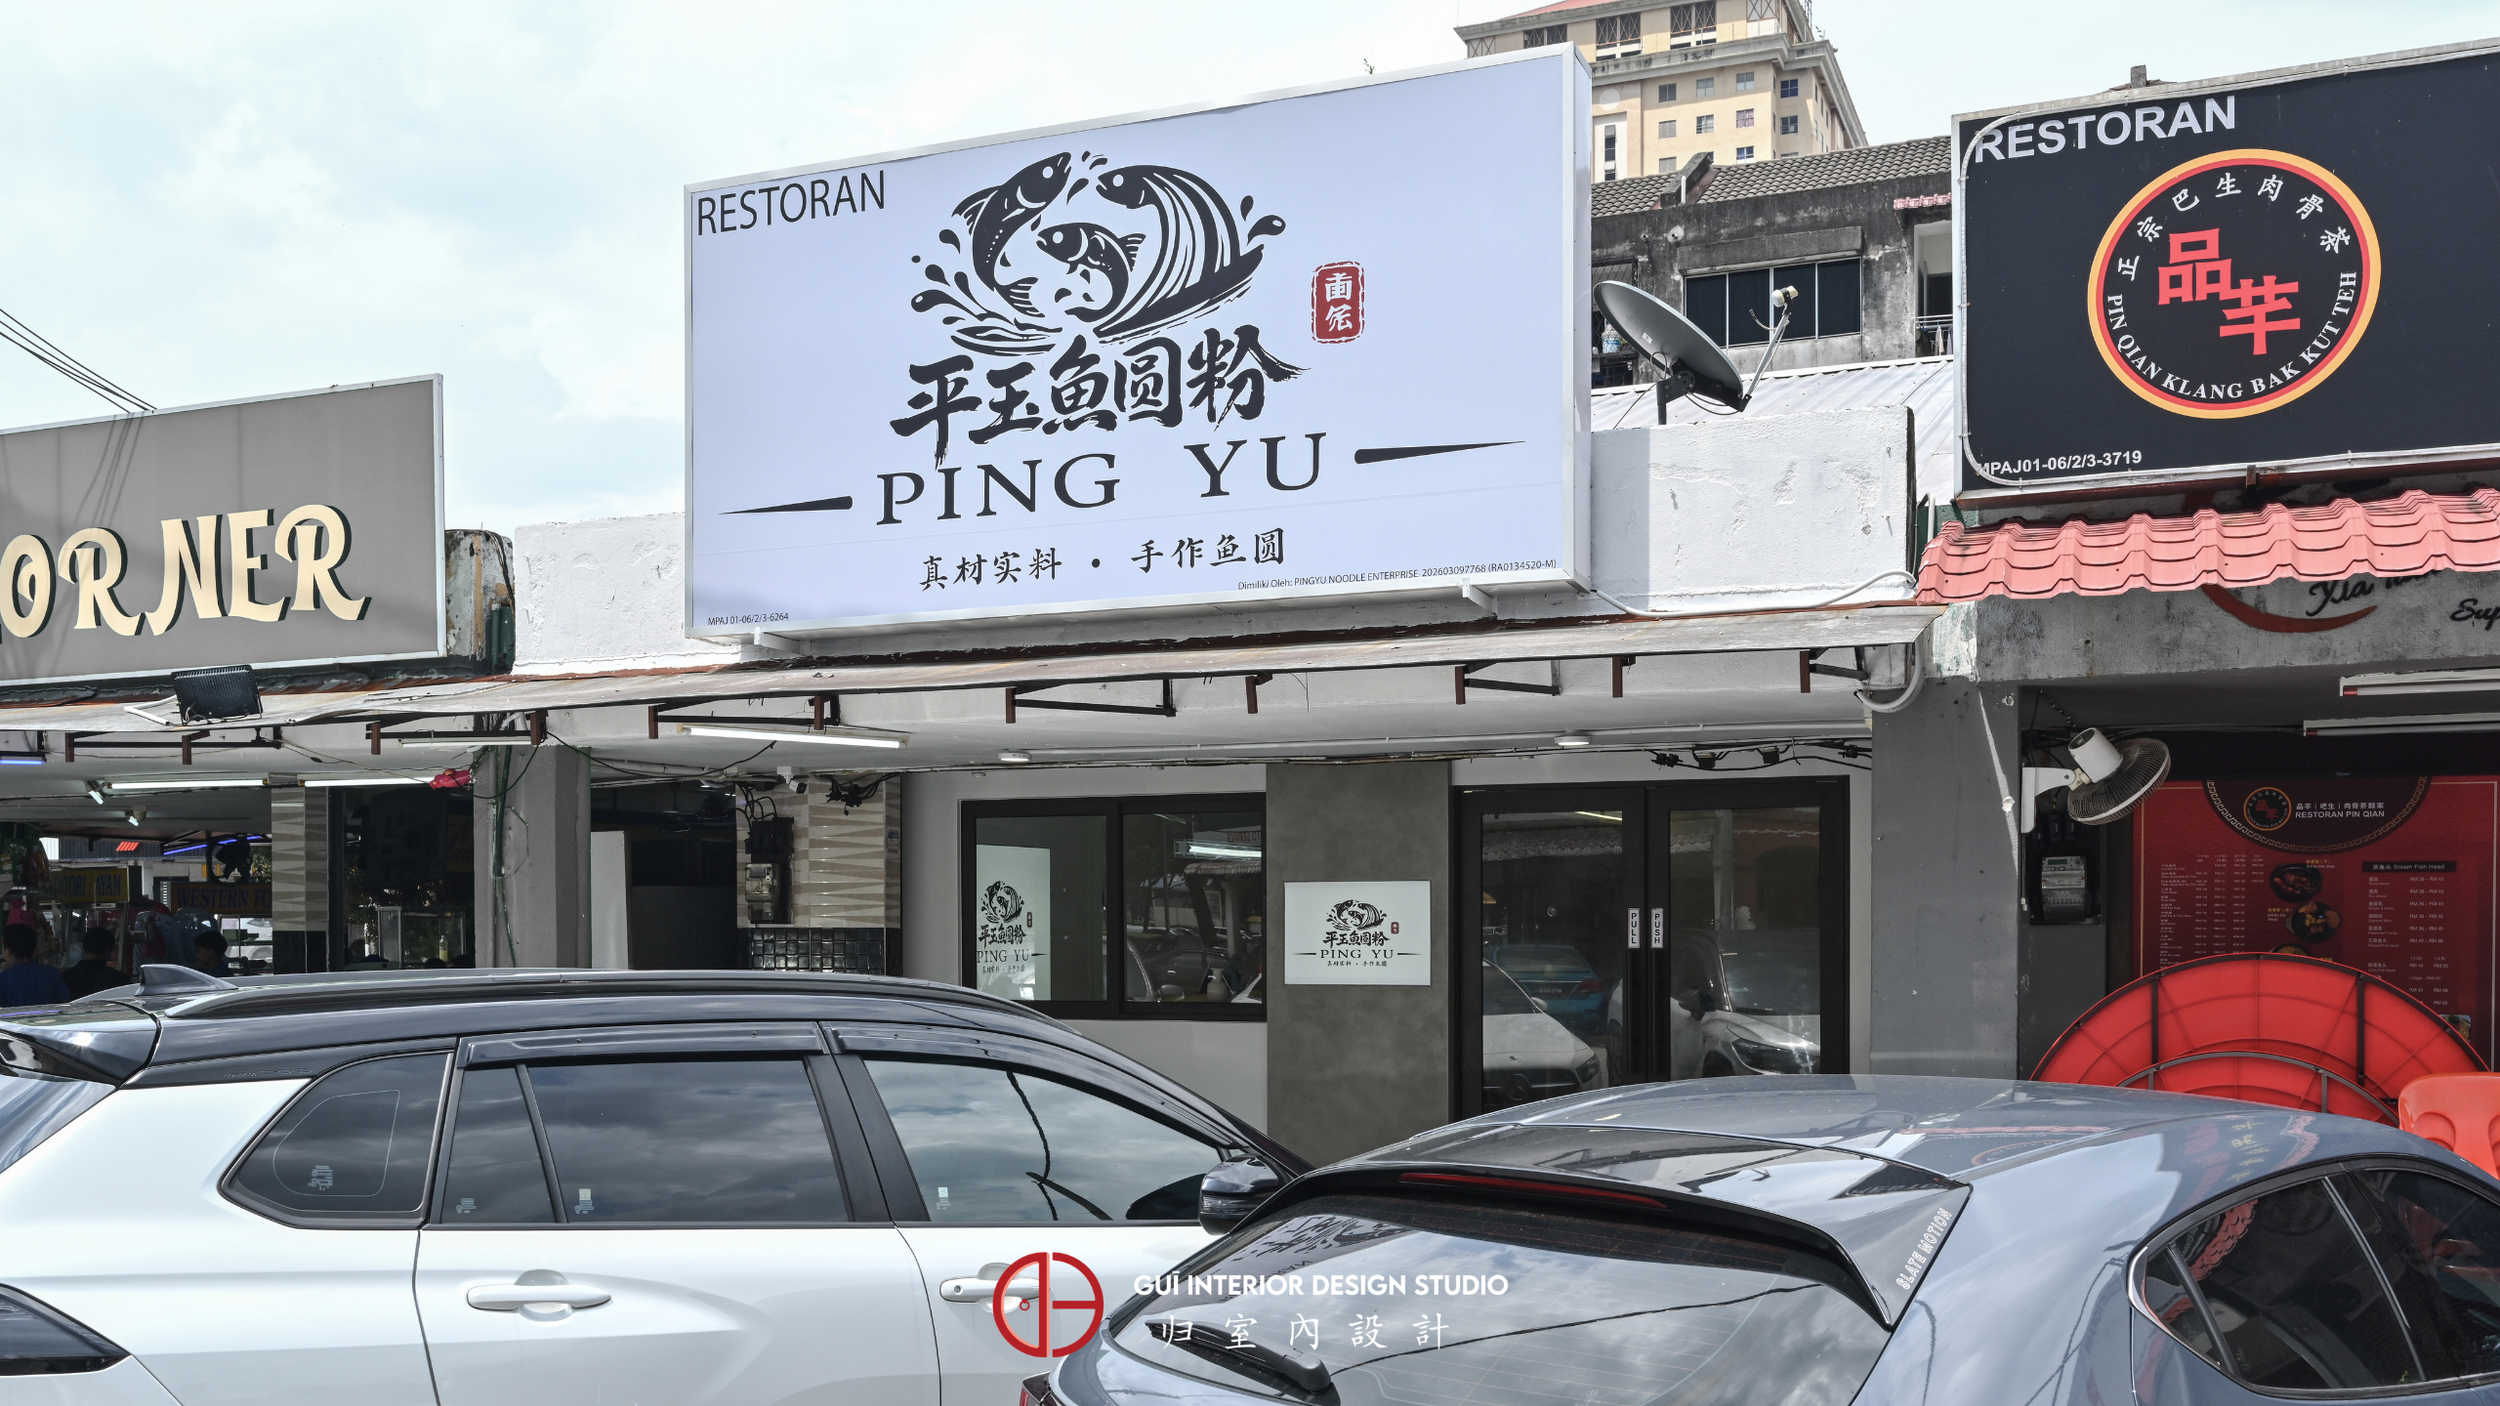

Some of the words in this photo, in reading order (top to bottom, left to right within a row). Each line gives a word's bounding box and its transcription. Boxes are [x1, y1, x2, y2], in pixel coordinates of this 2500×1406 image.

[1975, 95, 2236, 163] RESTORAN
[698, 169, 885, 236] RESTORAN
[2118, 173, 2350, 281] 正宗巴生肉骨茶
[2107, 294, 2127, 330] PIN
[2117, 334, 2162, 379] QIAN
[2161, 373, 2243, 399] KLANG
[2250, 361, 2300, 394] BAK
[2300, 320, 2340, 364] KUT
[2332, 272, 2357, 316] TEH
[876, 453, 1120, 525] PING
[1183, 432, 1326, 498] YU
[920, 547, 1062, 592] 真材实料
[1131, 527, 1284, 574] 手作鱼圆
[1270, 578, 1292, 588] Oleh:
[1294, 575, 1327, 586] PINGYU
[1328, 572, 1366, 584] NOODLE
[1367, 568, 1419, 581] ENTERPRISE
[1422, 564, 1486, 577] 202603097768
[1488, 559, 1557, 573] (RA0134520-M)
[708, 616, 729, 626] MPAJ
[729, 612, 789, 625] 01-06/2/3-6264
[2295, 810, 2344, 819] RESTORAN
[2346, 810, 2360, 818] PIN
[2363, 810, 2385, 818] QIAN
[96, 874, 122, 896] AYAM
[177, 888, 248, 908] WESTERN
[977, 950, 1007, 963] PING
[1014, 949, 1029, 961] YU
[1320, 949, 1361, 958] PING
[1371, 949, 1393, 959] YU
[1896, 1251, 1926, 1289] SLATE
[1918, 1208, 1952, 1254] MOTION
